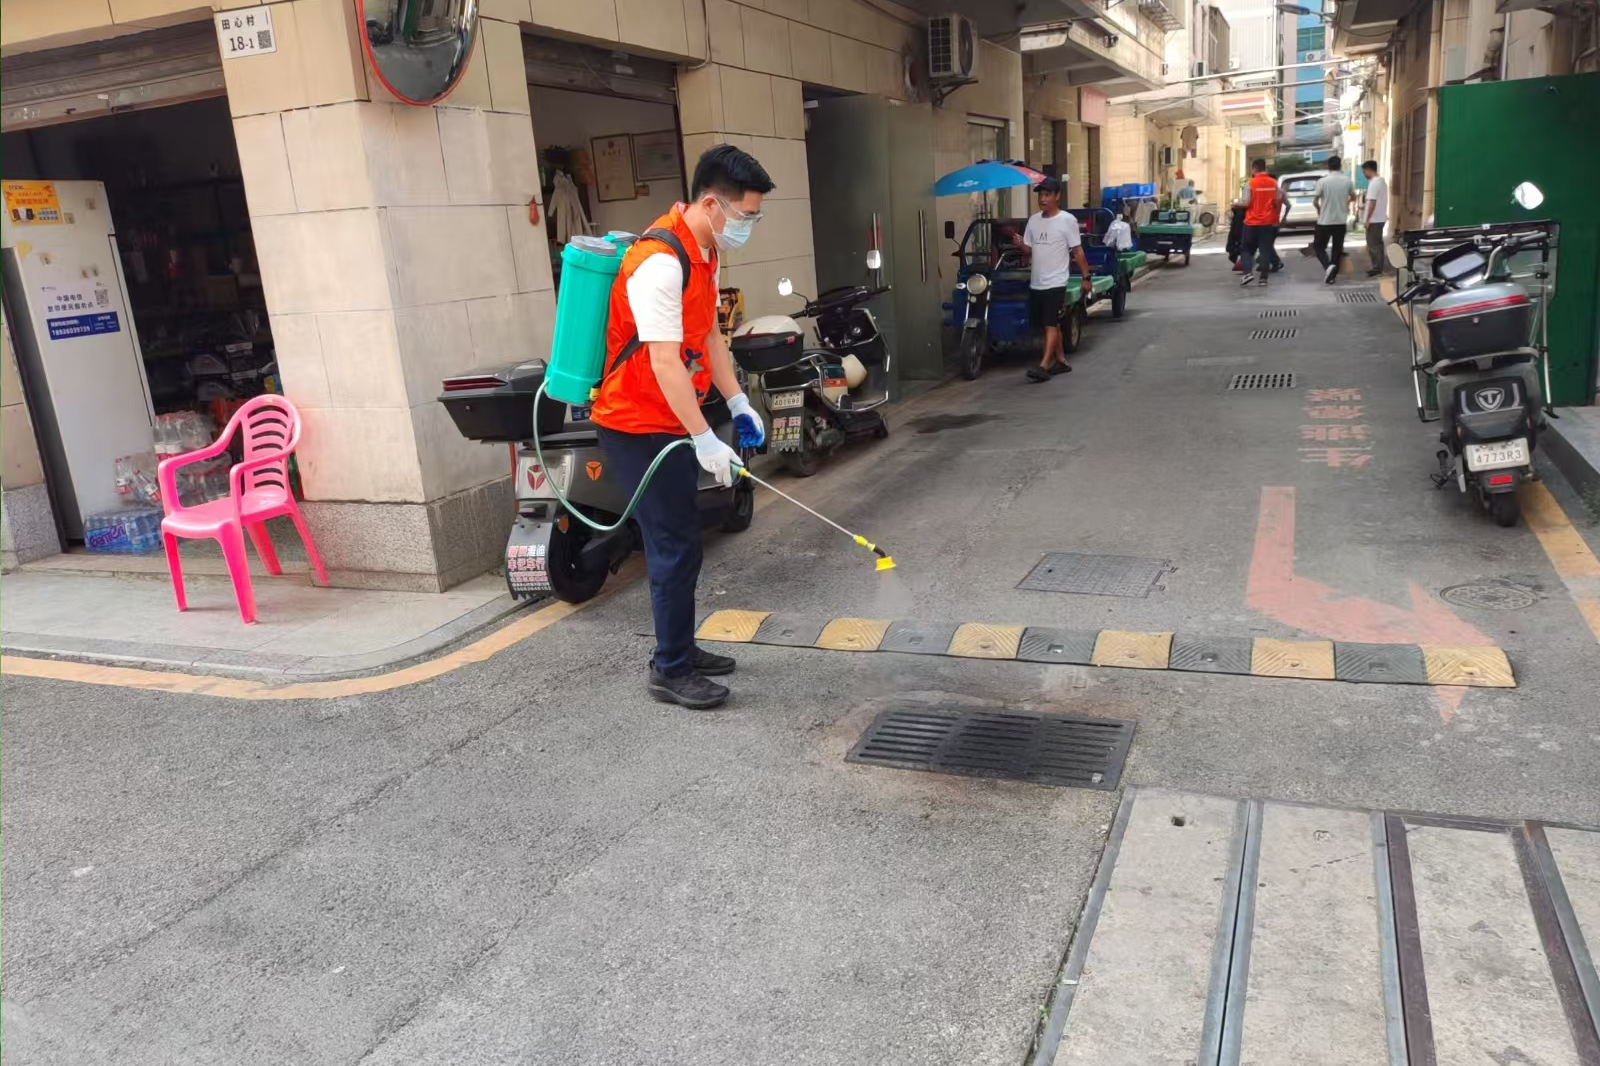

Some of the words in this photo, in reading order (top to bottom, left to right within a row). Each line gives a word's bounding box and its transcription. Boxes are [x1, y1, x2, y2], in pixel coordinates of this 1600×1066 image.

[221, 14, 255, 31] 田心村
[229, 35, 255, 52] 18-1
[56, 293, 83, 303] 中国电信
